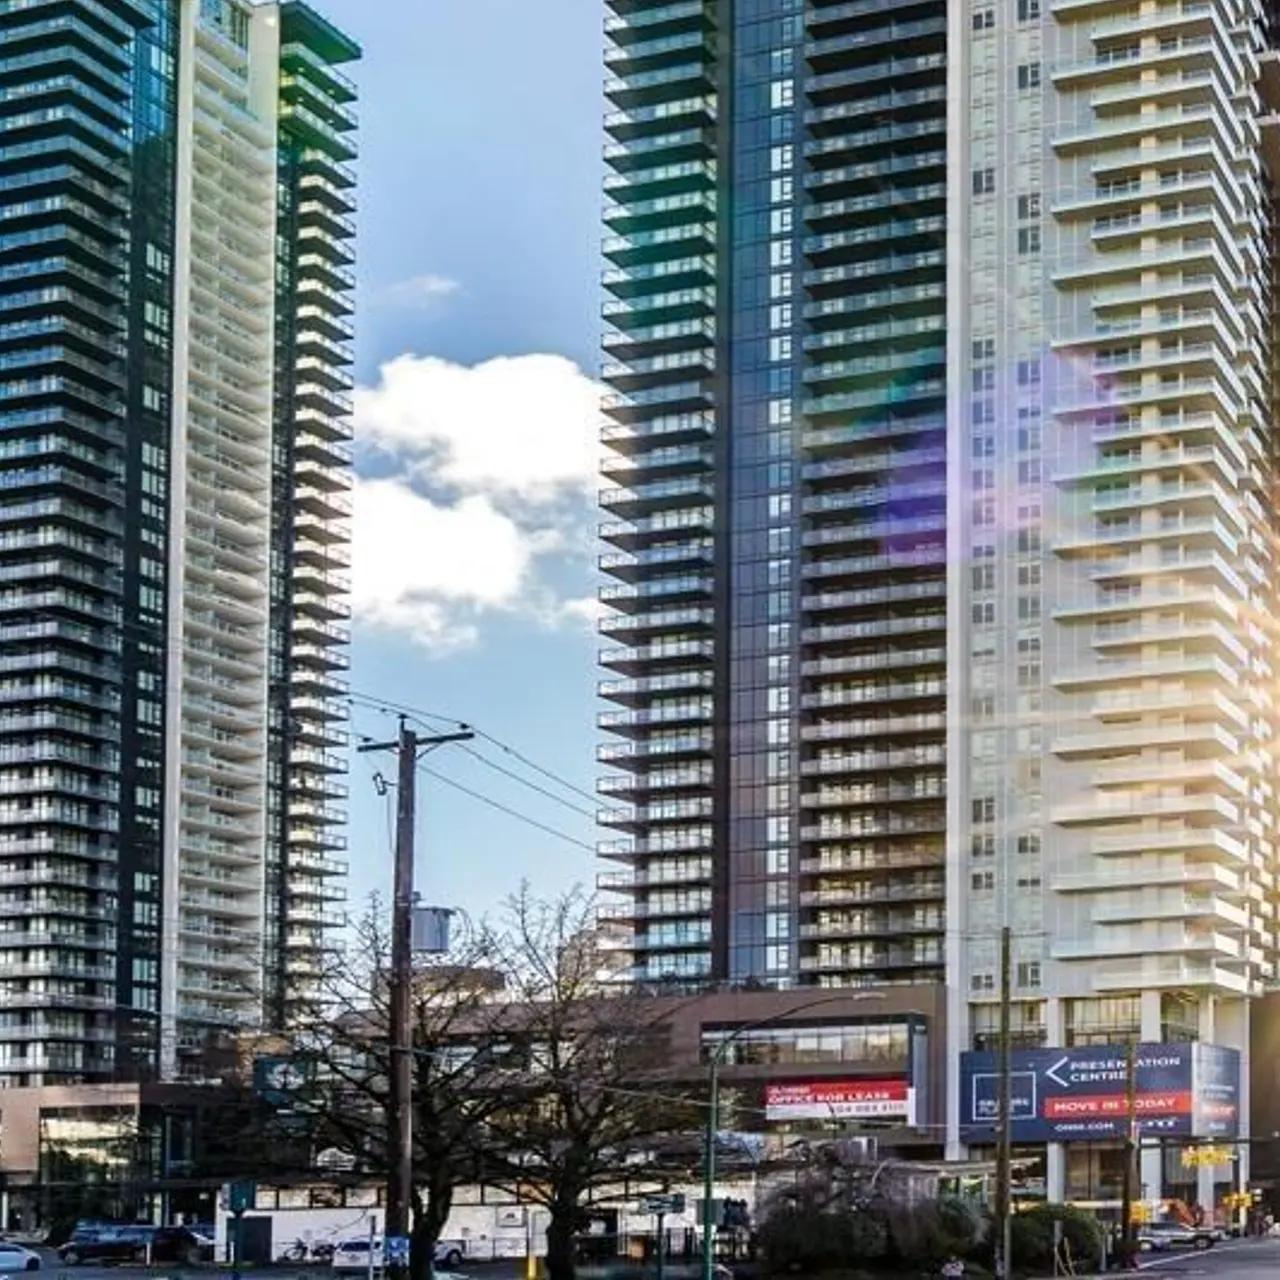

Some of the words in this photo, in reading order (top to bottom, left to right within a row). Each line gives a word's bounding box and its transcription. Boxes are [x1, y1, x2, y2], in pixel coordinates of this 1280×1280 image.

[1070, 1057, 1181, 1070] PRESENATION
[1070, 1070, 1128, 1082] CENTRE
[1053, 1100, 1098, 1112] MOVE
